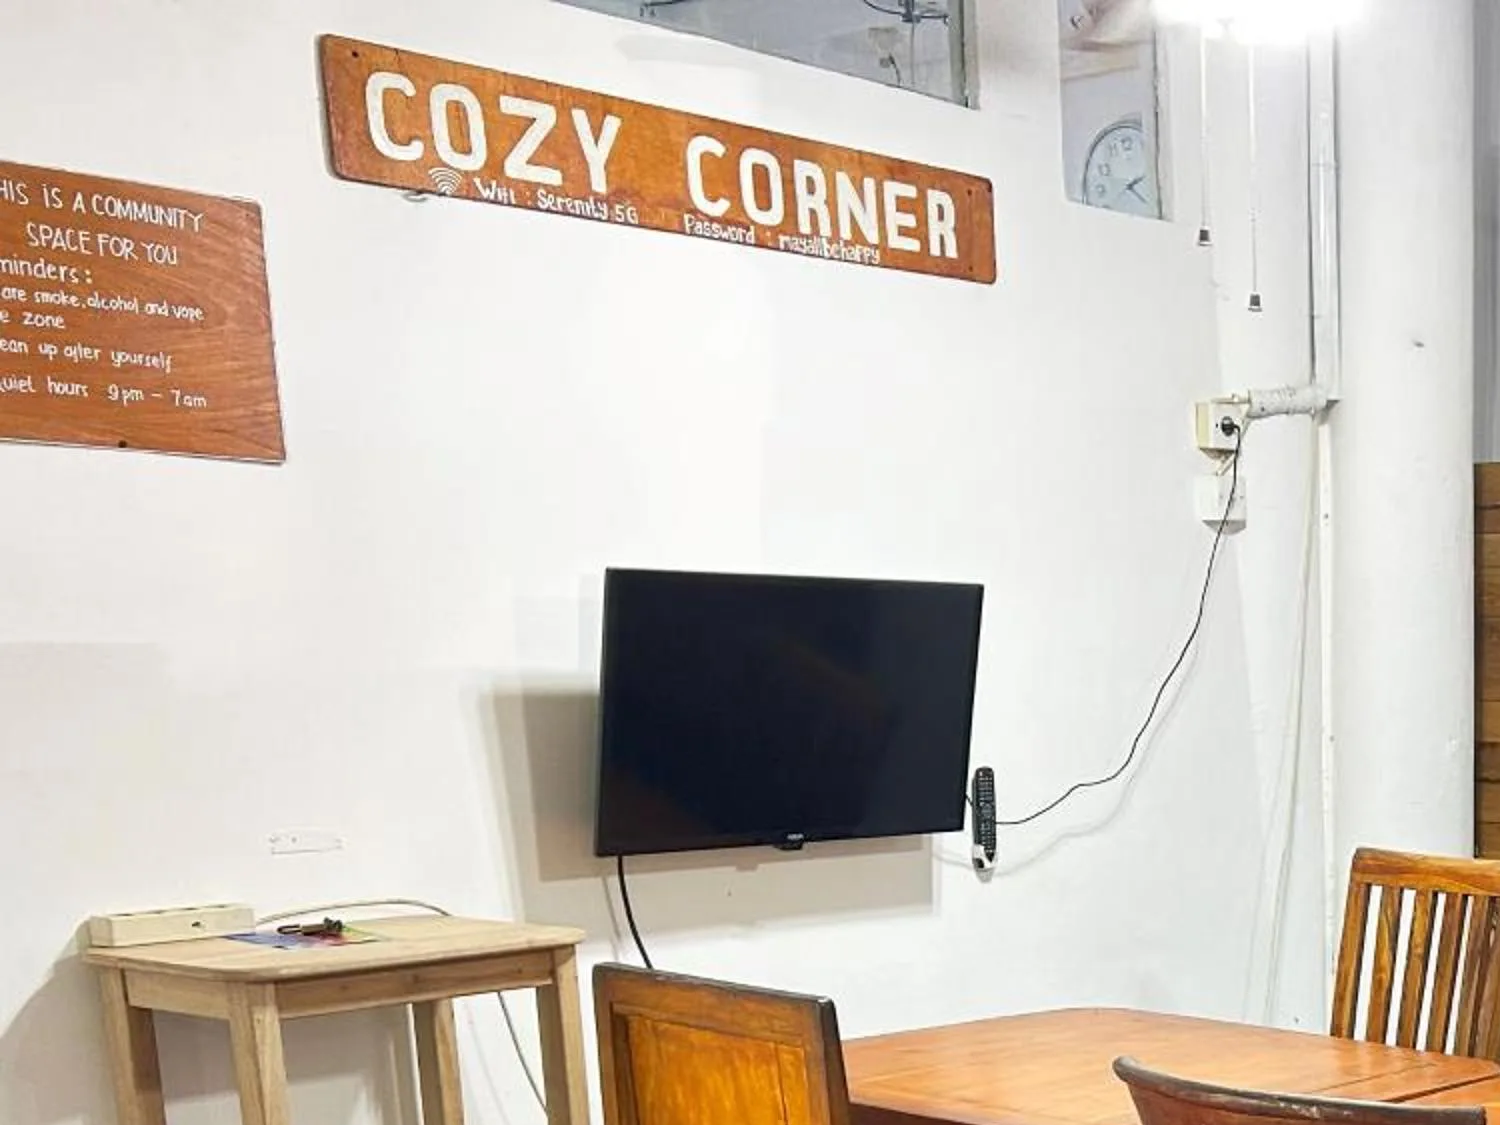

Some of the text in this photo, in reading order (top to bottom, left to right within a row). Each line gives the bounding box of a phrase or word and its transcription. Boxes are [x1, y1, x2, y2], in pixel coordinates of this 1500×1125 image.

[365, 72, 959, 259] COZY CORNER
[72, 192, 86, 213] A
[92, 196, 203, 232] COMMUNITY
[26, 223, 177, 265] SPACE FOR YOU
[683, 213, 755, 244] Password
[23, 312, 65, 329] zone
[145, 302, 168, 316] and
[173, 306, 204, 322] vape
[39, 341, 57, 361] up
[63, 342, 101, 364] after
[111, 351, 172, 373] yourself
[47, 376, 88, 396] hours
[107, 384, 144, 406] 9pm
